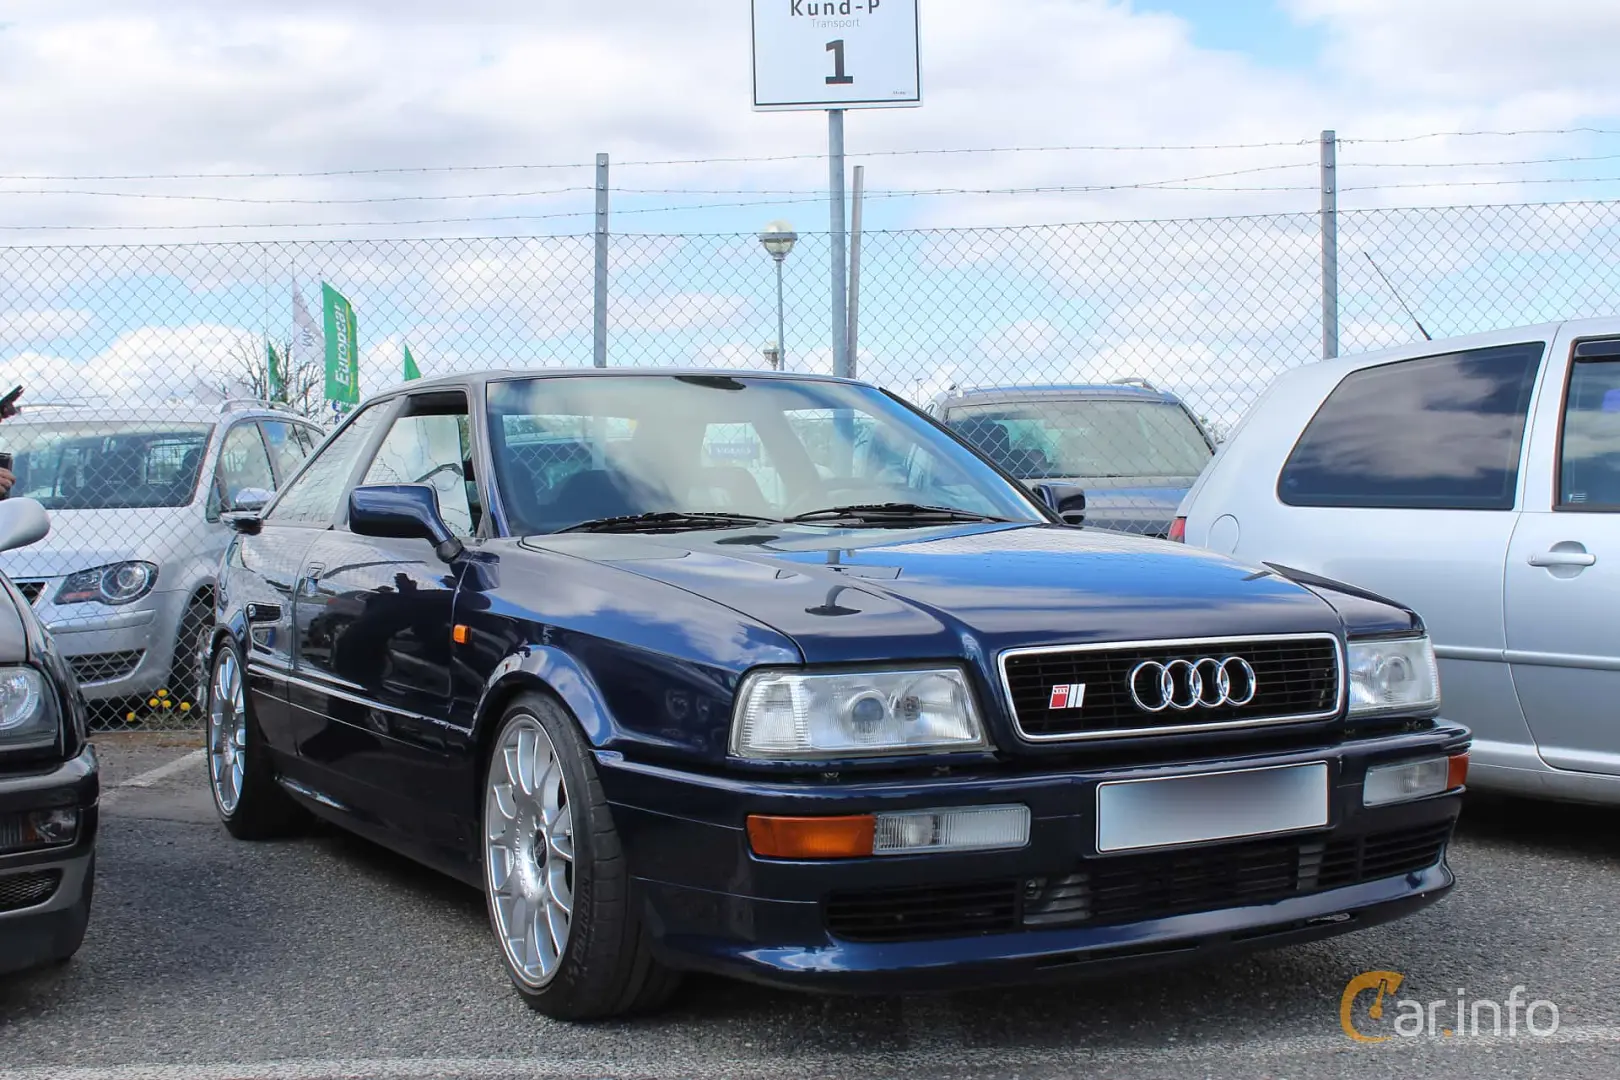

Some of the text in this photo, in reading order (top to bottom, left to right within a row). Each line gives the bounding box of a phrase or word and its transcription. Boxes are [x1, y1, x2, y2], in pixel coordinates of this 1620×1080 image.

[791, 0, 880, 16] Kund-P
[811, 18, 860, 29] Transport
[825, 39, 853, 84] 1
[334, 303, 349, 386] Europcar
